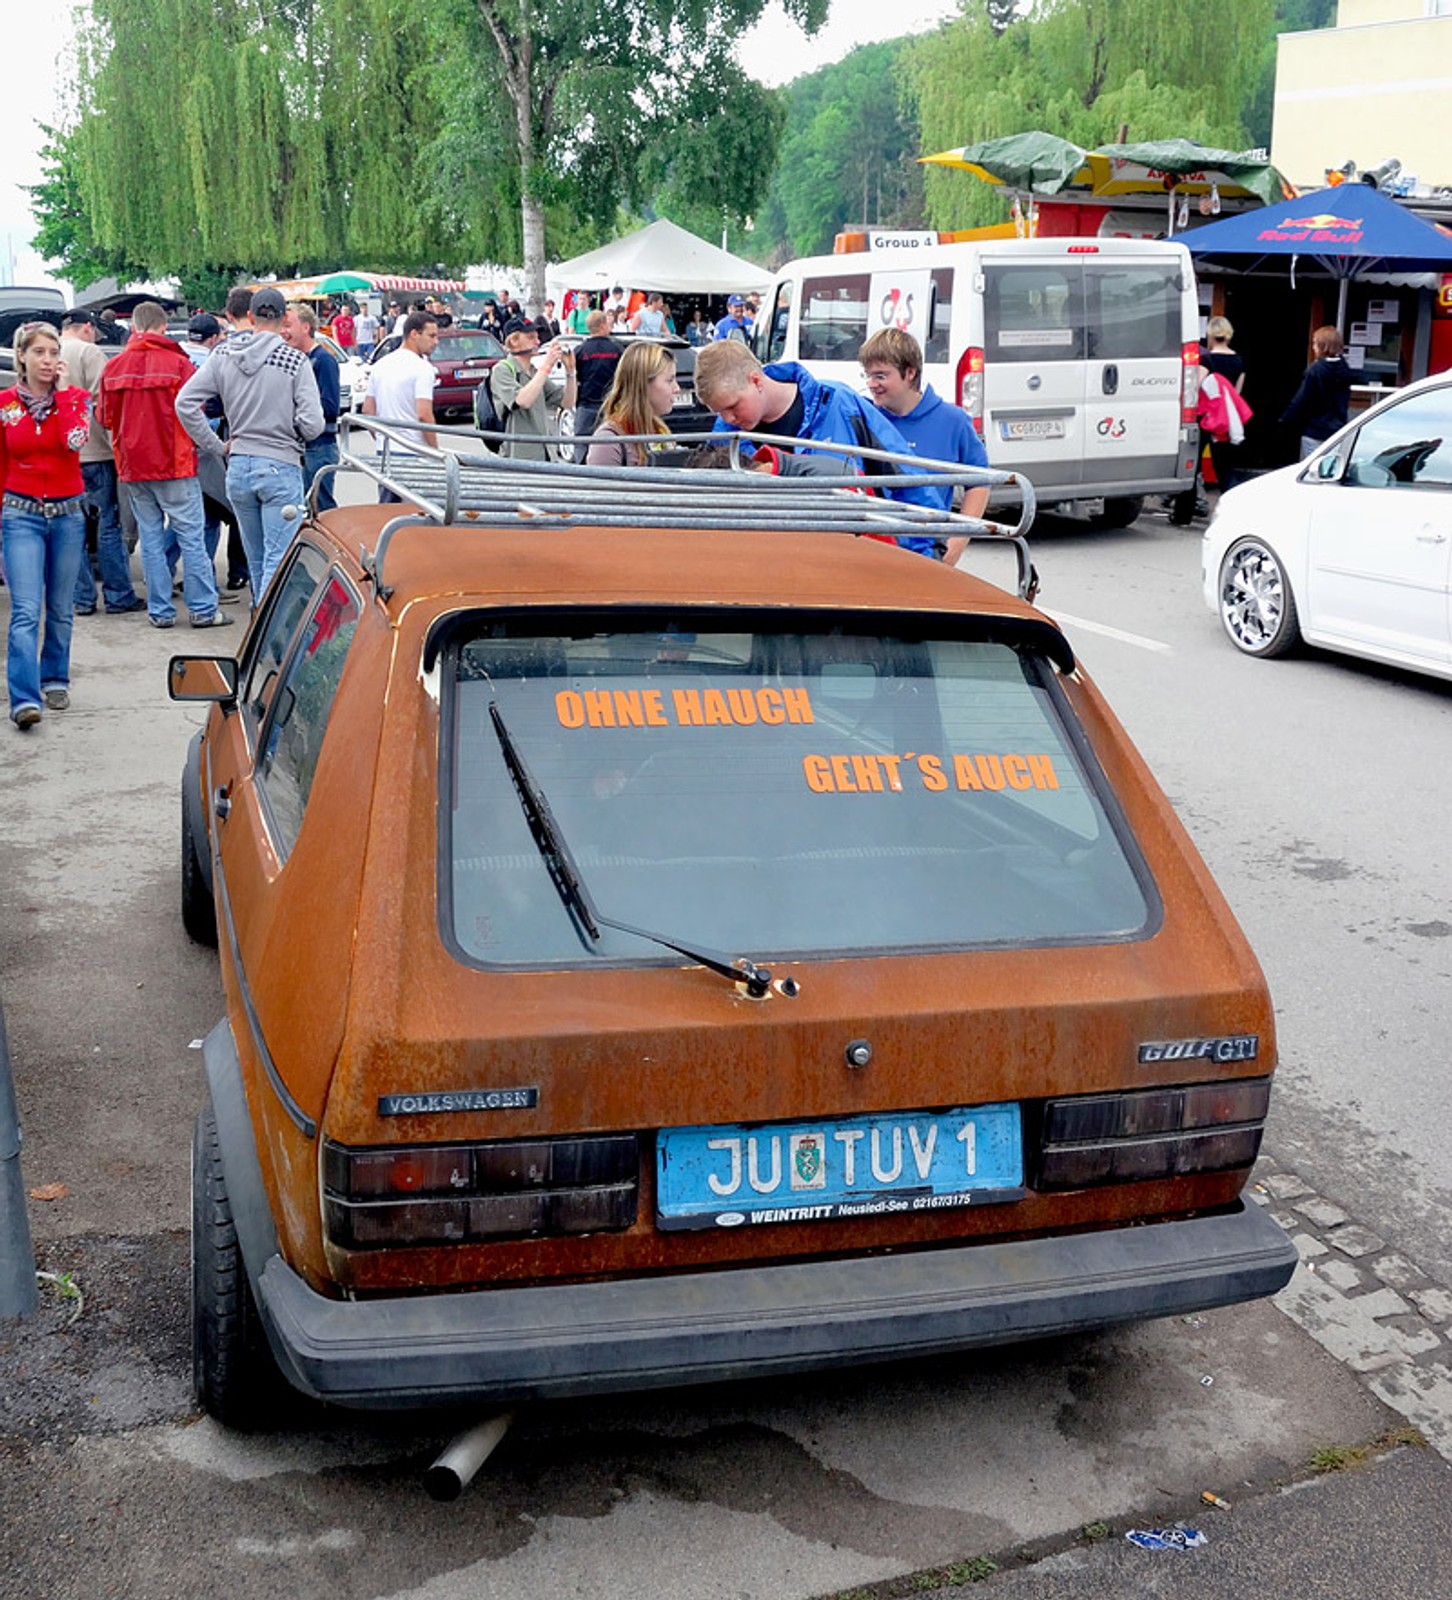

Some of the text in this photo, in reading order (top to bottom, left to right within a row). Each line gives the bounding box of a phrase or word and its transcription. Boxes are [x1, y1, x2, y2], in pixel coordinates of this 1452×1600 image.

[874, 237, 933, 249] Group 4
[1256, 228, 1364, 243] Red Bull
[555, 687, 815, 729] OHNE HAUCH
[954, 753, 1059, 791] AUCH
[1144, 1037, 1257, 1060] GOLF GTI
[389, 1091, 528, 1112] VOLKSWAGEN
[708, 1121, 977, 1195] JU TUV 1
[750, 1205, 833, 1224] WEINTRITT
[838, 1200, 909, 1217] Neusiedl-See
